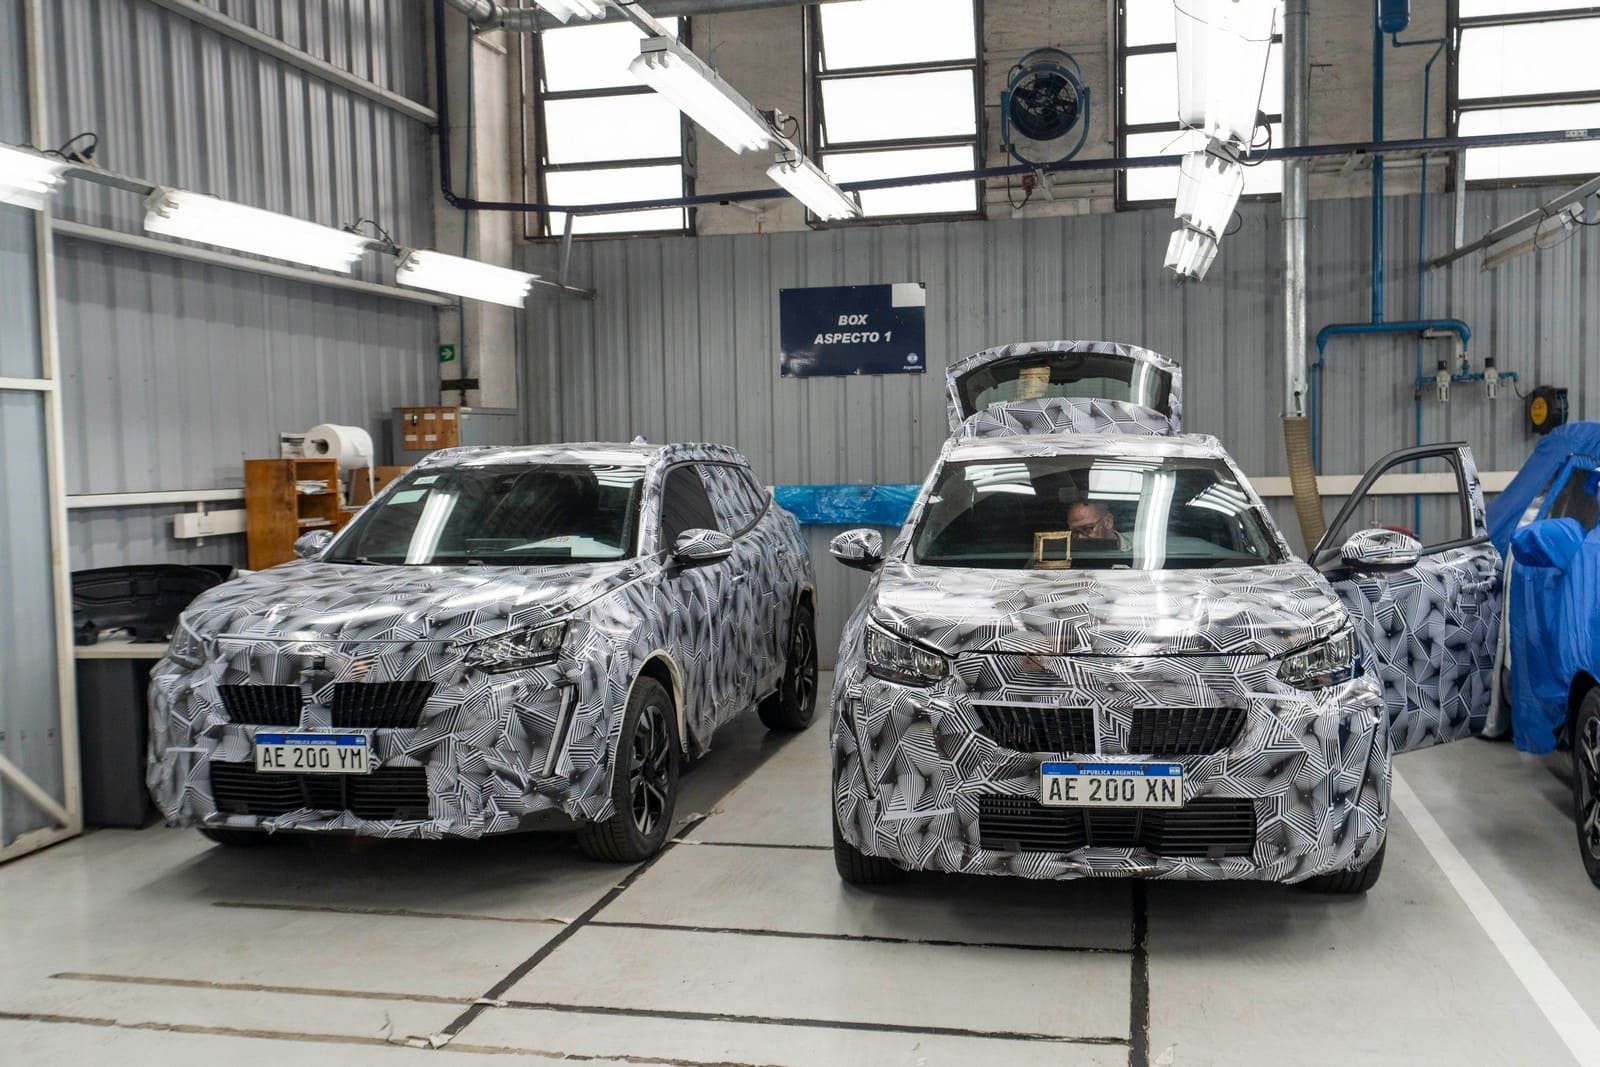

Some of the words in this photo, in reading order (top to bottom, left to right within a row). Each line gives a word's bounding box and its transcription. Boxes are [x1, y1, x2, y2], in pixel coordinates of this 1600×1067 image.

[838, 314, 869, 326] BOX
[814, 332, 880, 345] ASPECTO
[884, 331, 892, 342] 1
[263, 747, 286, 768] AE
[293, 747, 330, 768] 200
[338, 748, 362, 769] YM
[1049, 777, 1079, 801] AE
[1089, 778, 1135, 801] 200
[1146, 778, 1176, 802] XN
